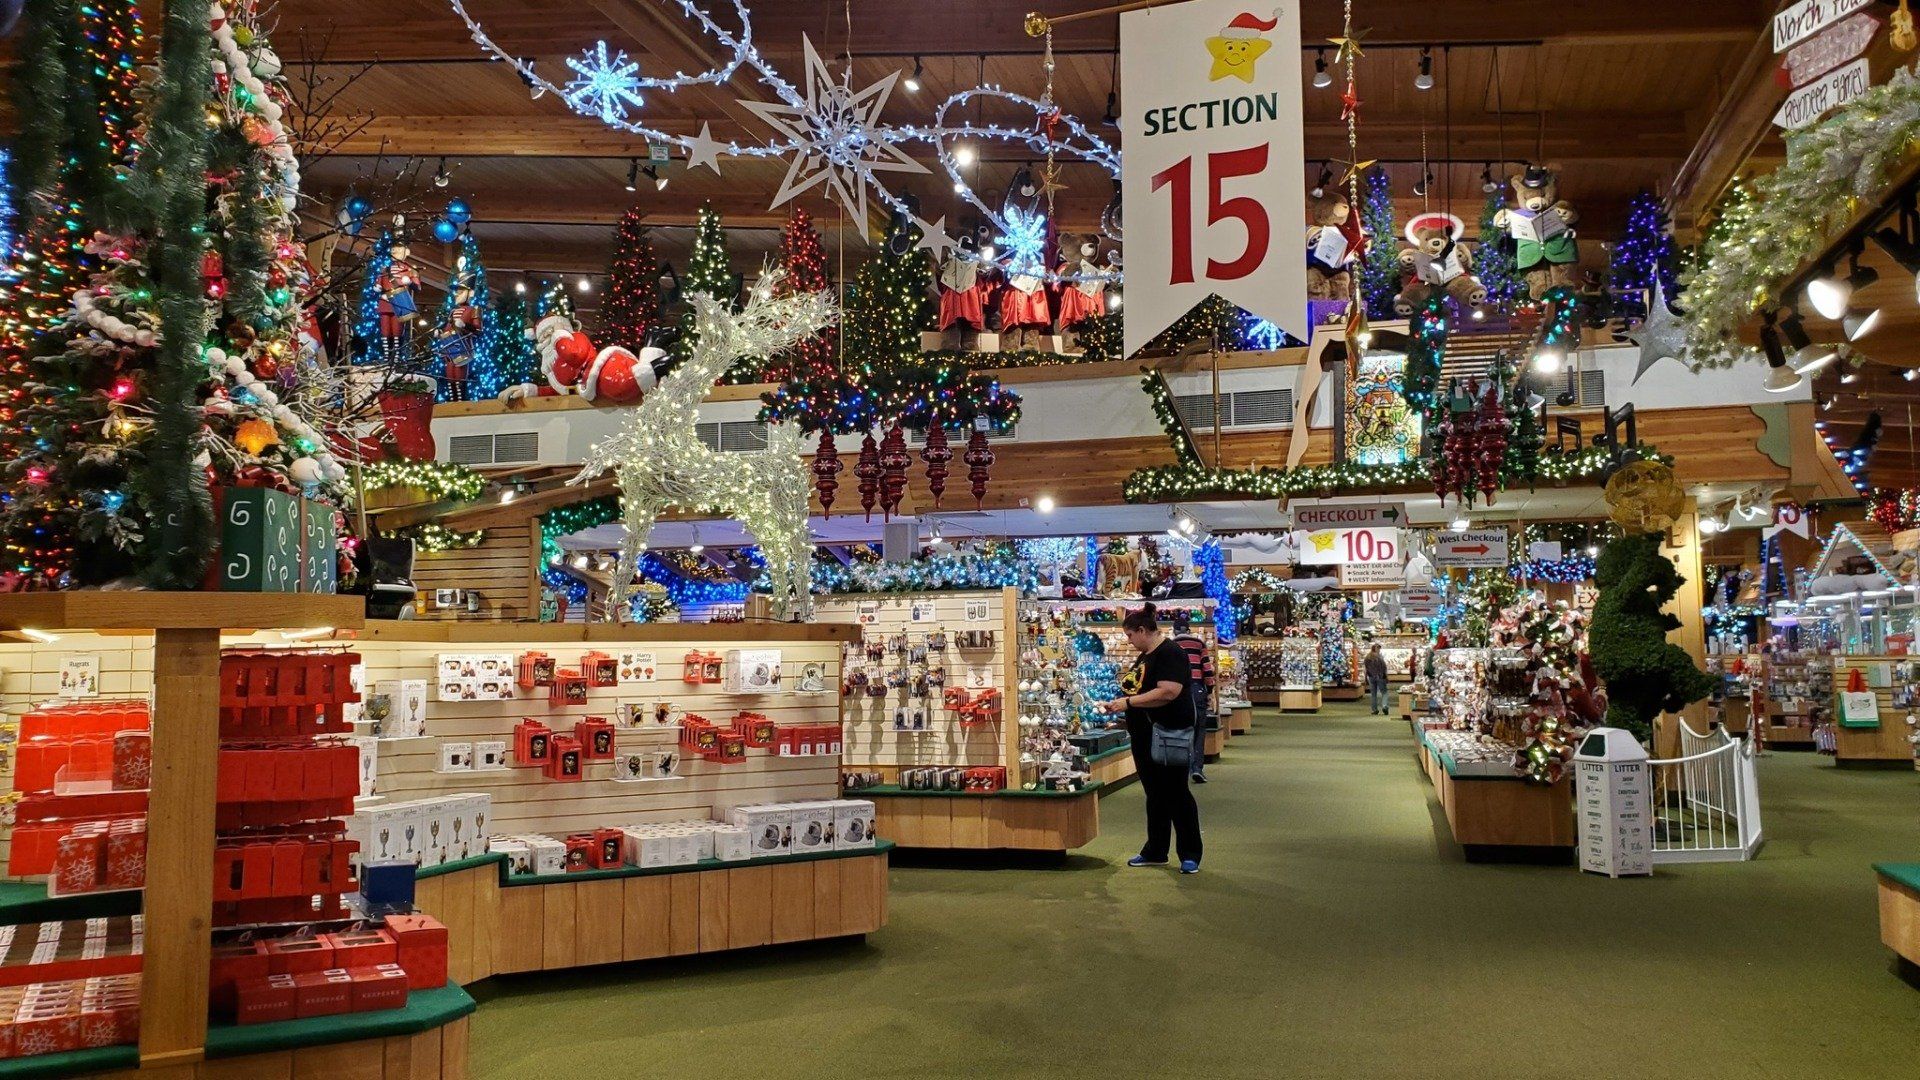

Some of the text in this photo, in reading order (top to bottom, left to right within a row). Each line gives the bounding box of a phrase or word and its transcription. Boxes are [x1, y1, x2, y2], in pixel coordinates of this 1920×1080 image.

[1144, 92, 1278, 136] SECTION
[1151, 142, 1270, 285] 15
[1299, 509, 1377, 523] CHECKOUT
[1438, 534, 1504, 544] West Checkout
[1578, 592, 1597, 603] EX
[1582, 763, 1604, 772] LITTER
[1614, 764, 1641, 772] LITTER
[362, 990, 401, 999] KEEPSAKE
